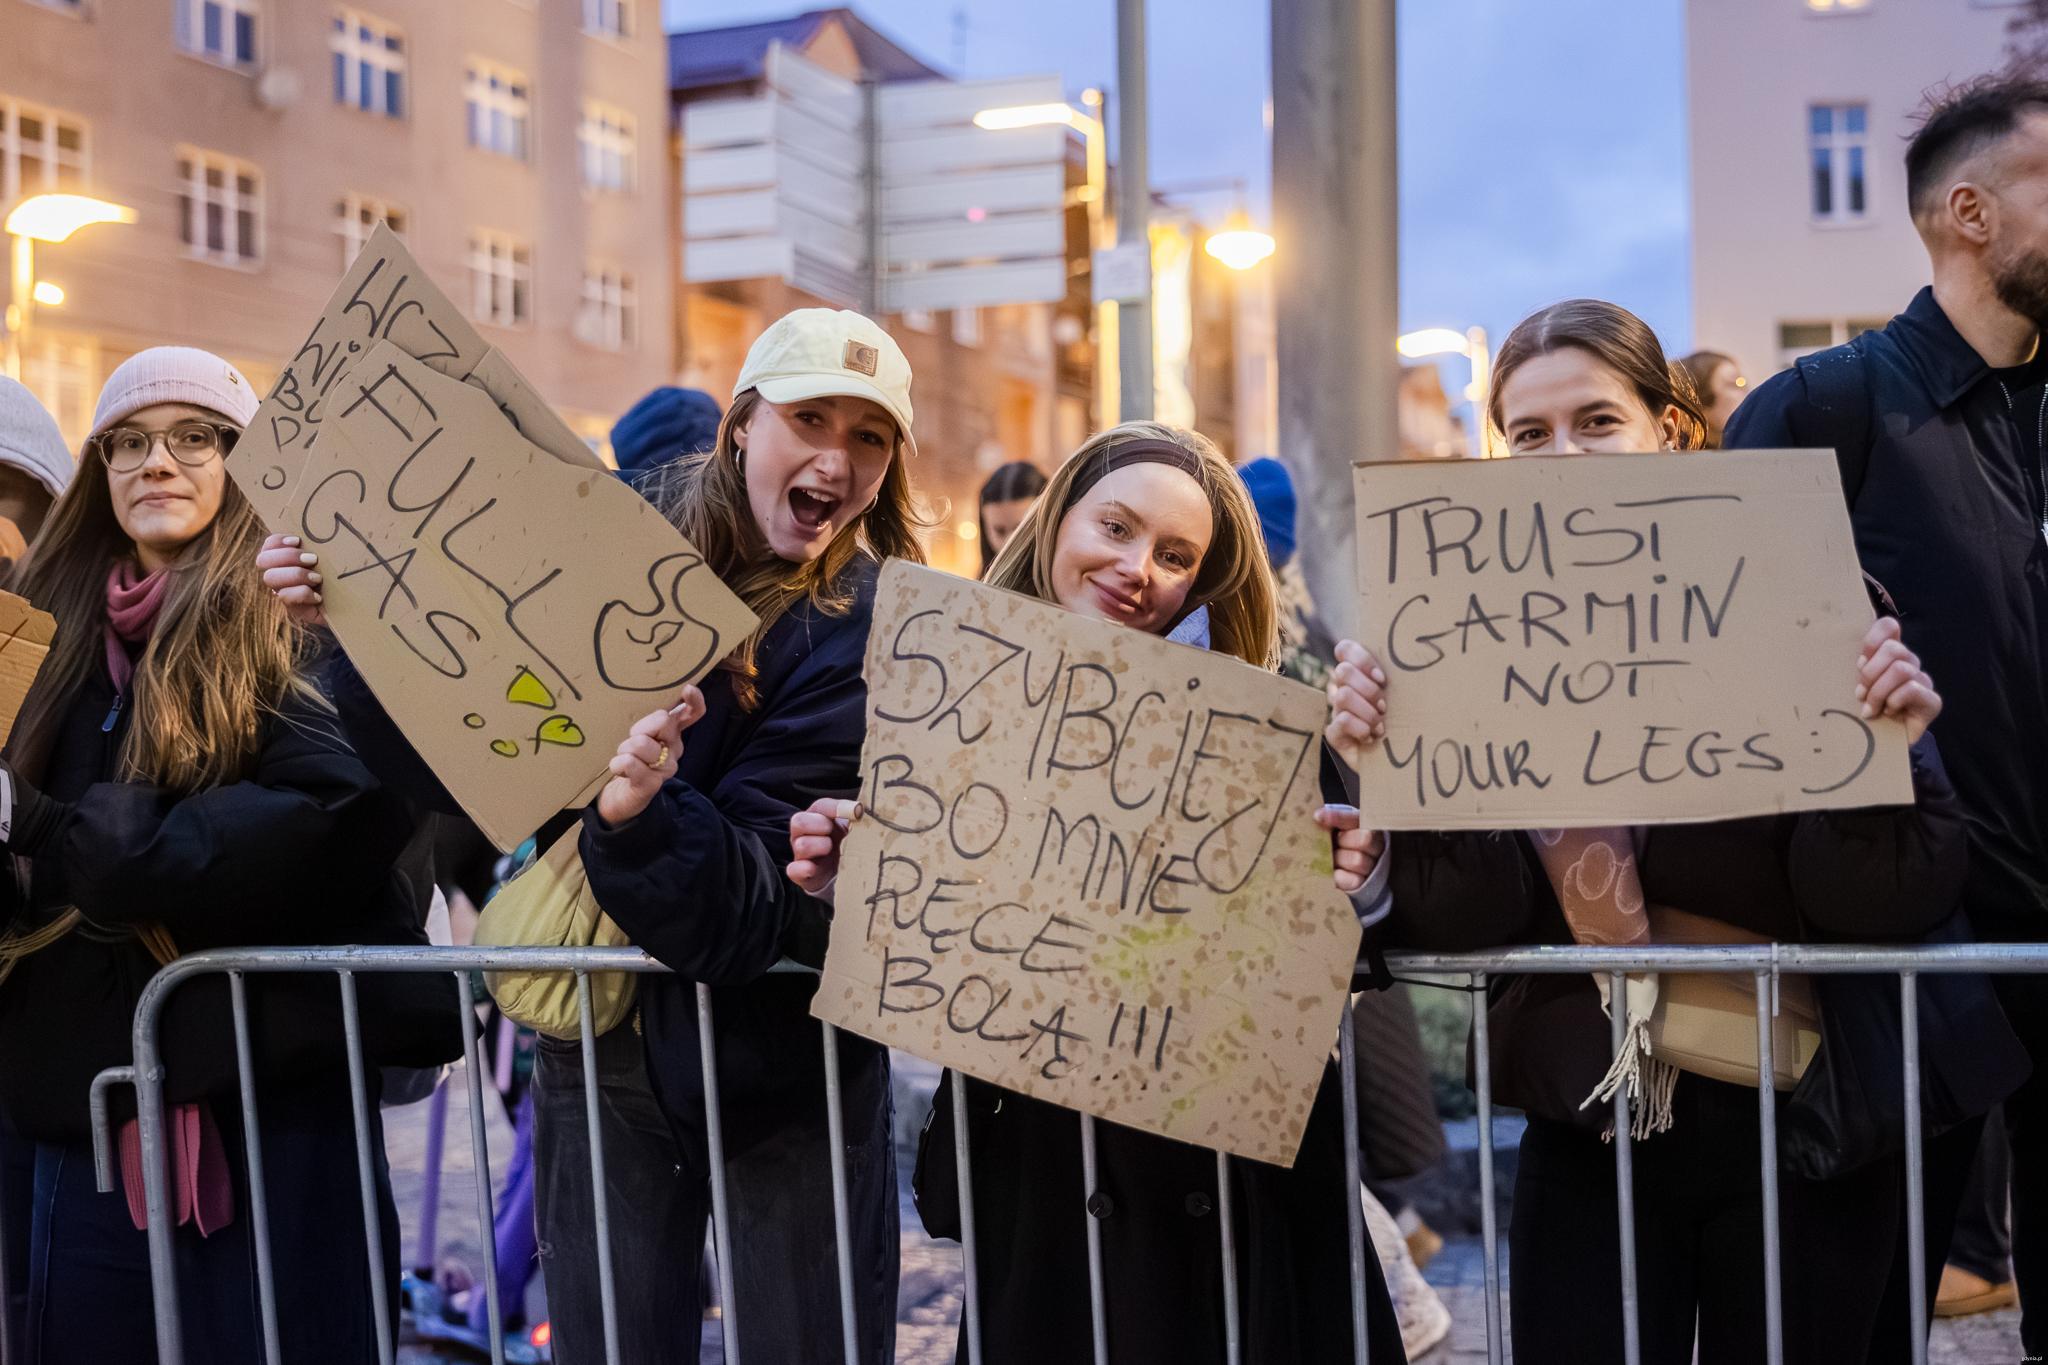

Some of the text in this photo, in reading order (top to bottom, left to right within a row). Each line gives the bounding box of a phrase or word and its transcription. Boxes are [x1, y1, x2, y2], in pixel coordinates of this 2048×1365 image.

[340, 363, 583, 701] FULL
[1366, 494, 1743, 584] TRUST
[1502, 660, 1692, 706] NOT
[864, 753, 1009, 860] BO
[1382, 733, 1552, 806] YOUR
[1582, 724, 1784, 785] LEGS
